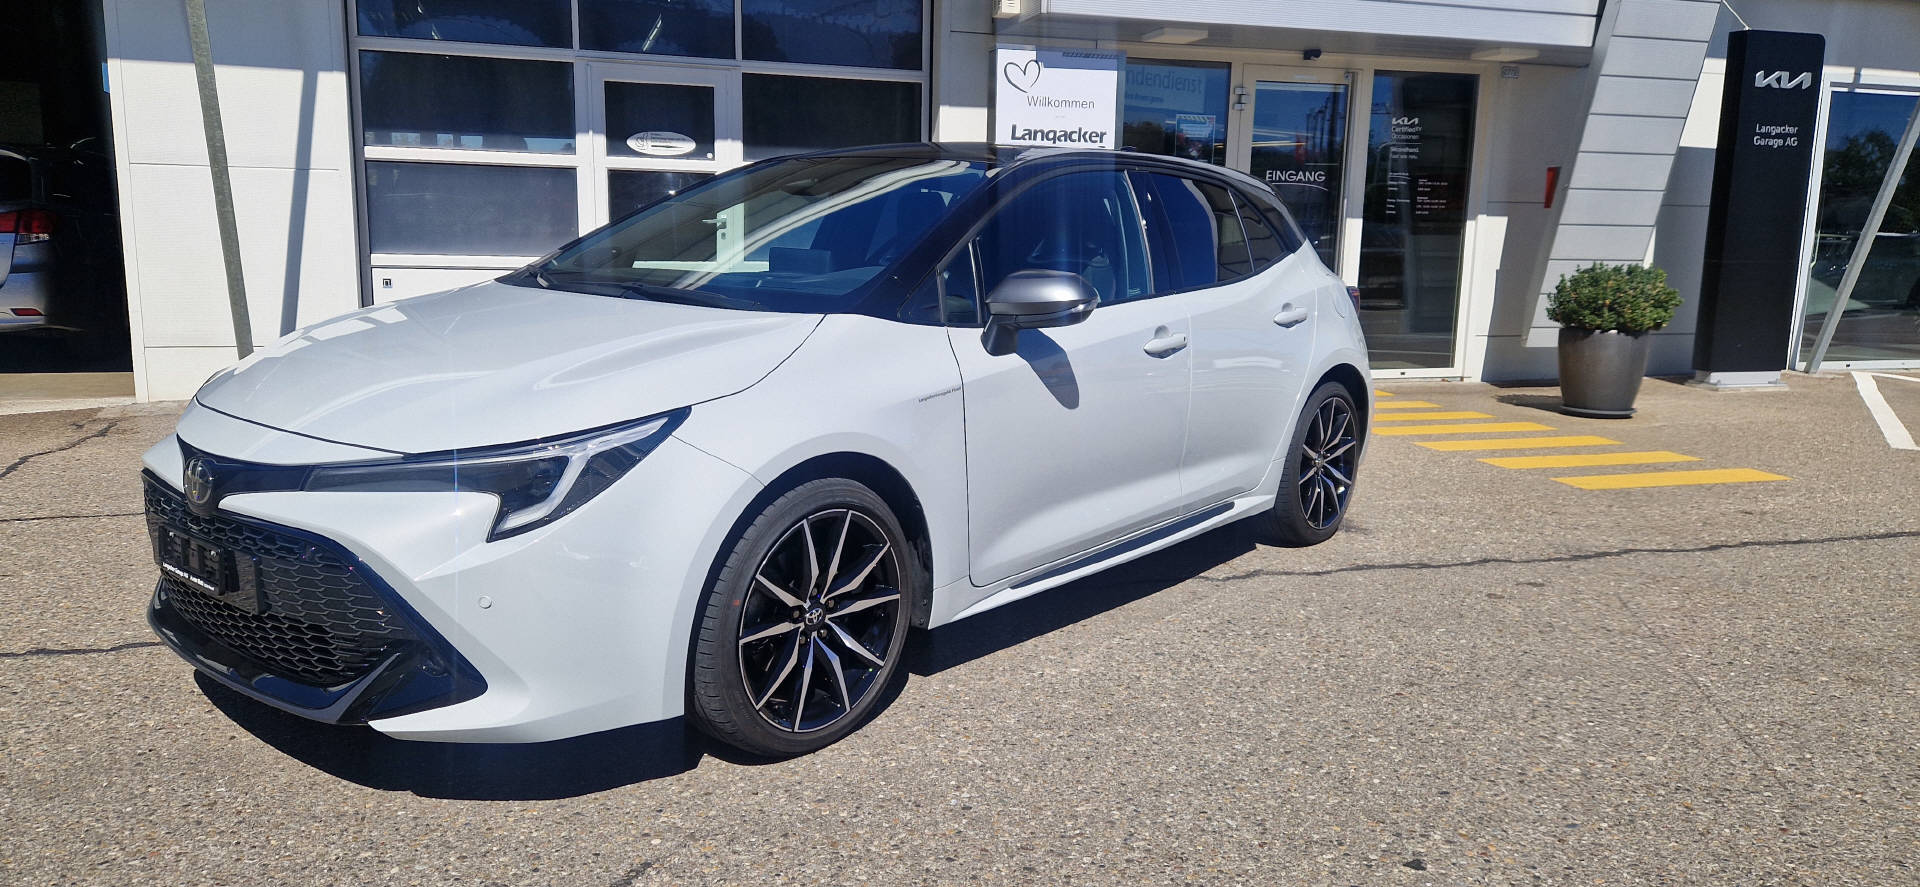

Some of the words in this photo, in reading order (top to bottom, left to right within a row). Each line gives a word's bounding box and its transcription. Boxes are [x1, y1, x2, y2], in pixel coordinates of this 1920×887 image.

[1126, 66, 1202, 94] ndendienst
[1027, 96, 1095, 109] Willkommen
[1756, 123, 1799, 136] Langacker
[1754, 136, 1783, 148] Garage
[1785, 137, 1799, 147] AG
[1266, 170, 1326, 182] EINGANG
